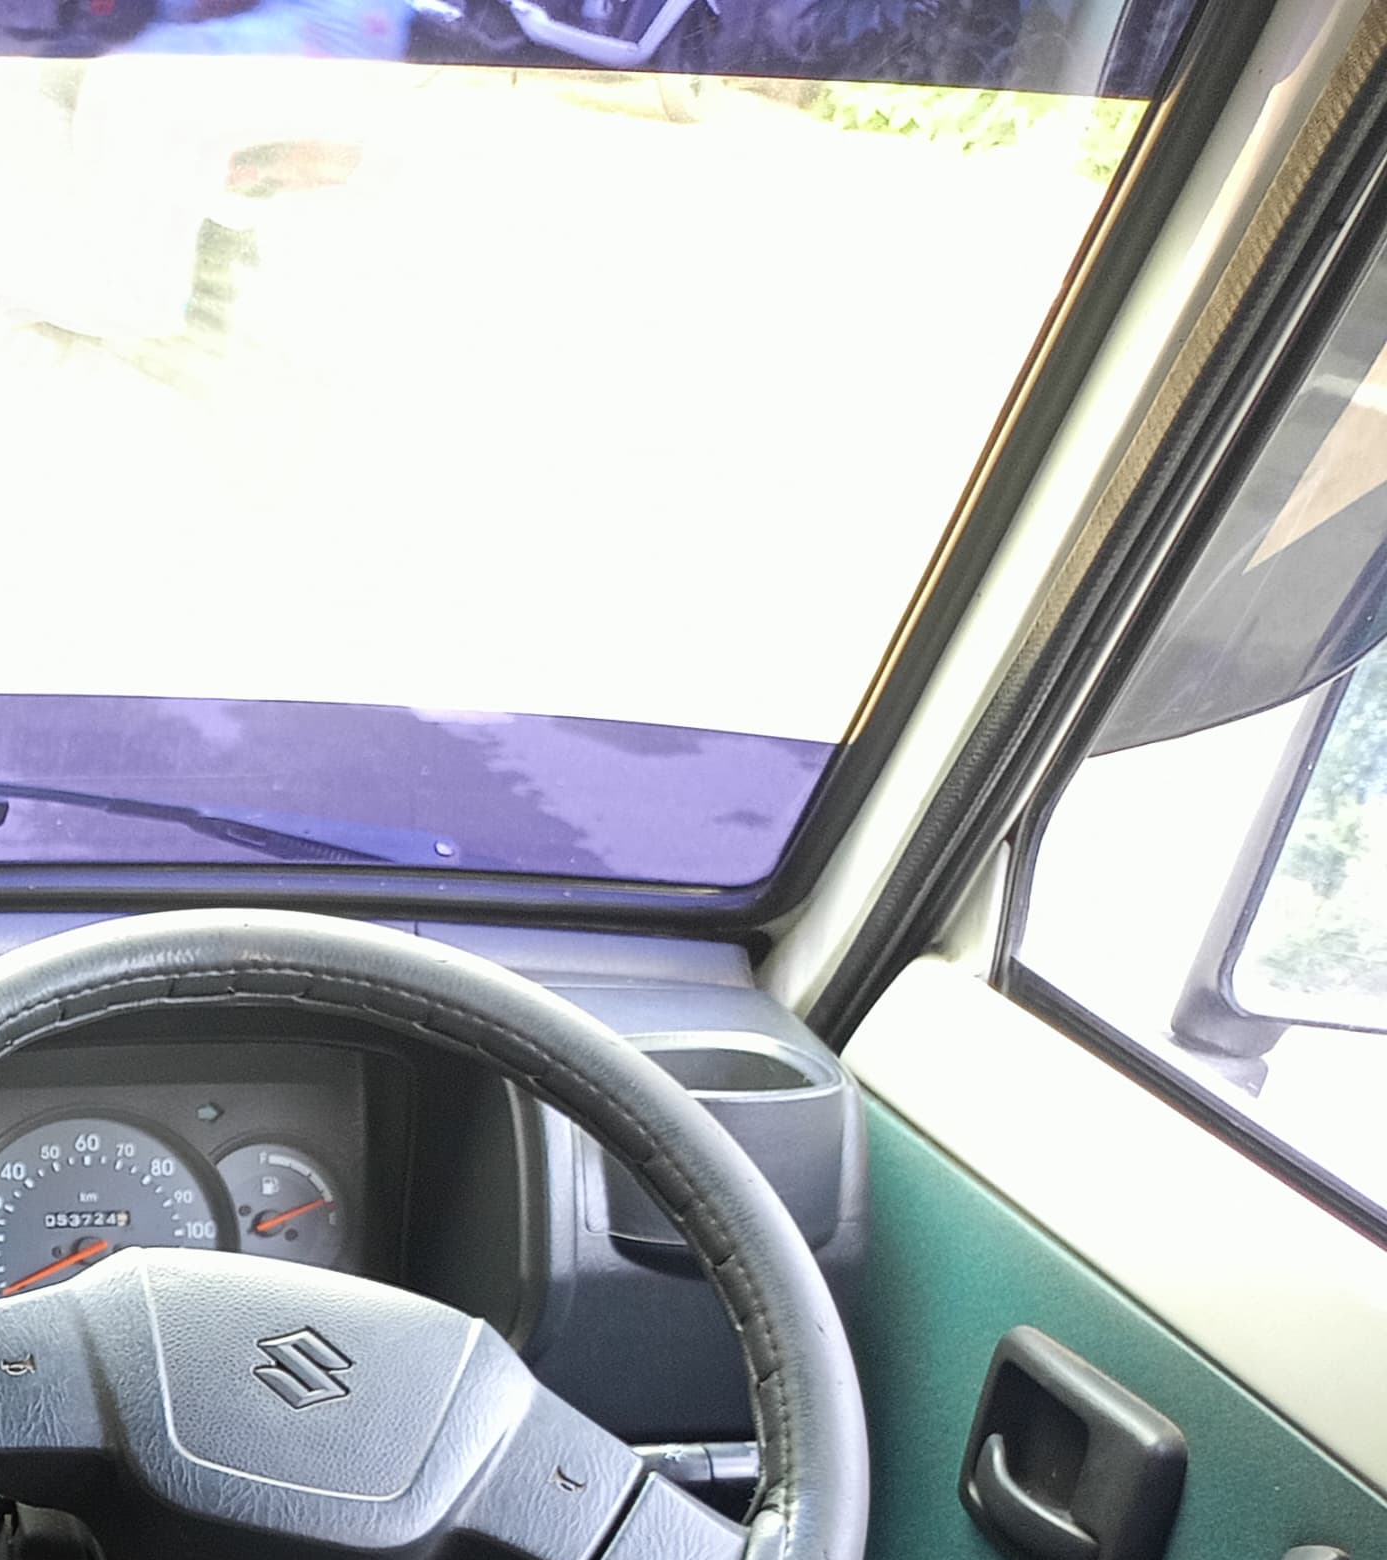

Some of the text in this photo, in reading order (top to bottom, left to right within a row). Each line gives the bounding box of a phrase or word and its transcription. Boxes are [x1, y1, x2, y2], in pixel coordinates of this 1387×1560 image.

[74, 1134, 100, 1152] 60
[116, 1143, 135, 1158] 70
[40, 1145, 60, 1160] 50
[258, 1151, 268, 1165] F
[0, 1162, 25, 1181] 40
[150, 1158, 174, 1177] 80
[79, 1192, 98, 1202] km
[173, 1189, 193, 1204] 90
[185, 1221, 216, 1239] 100
